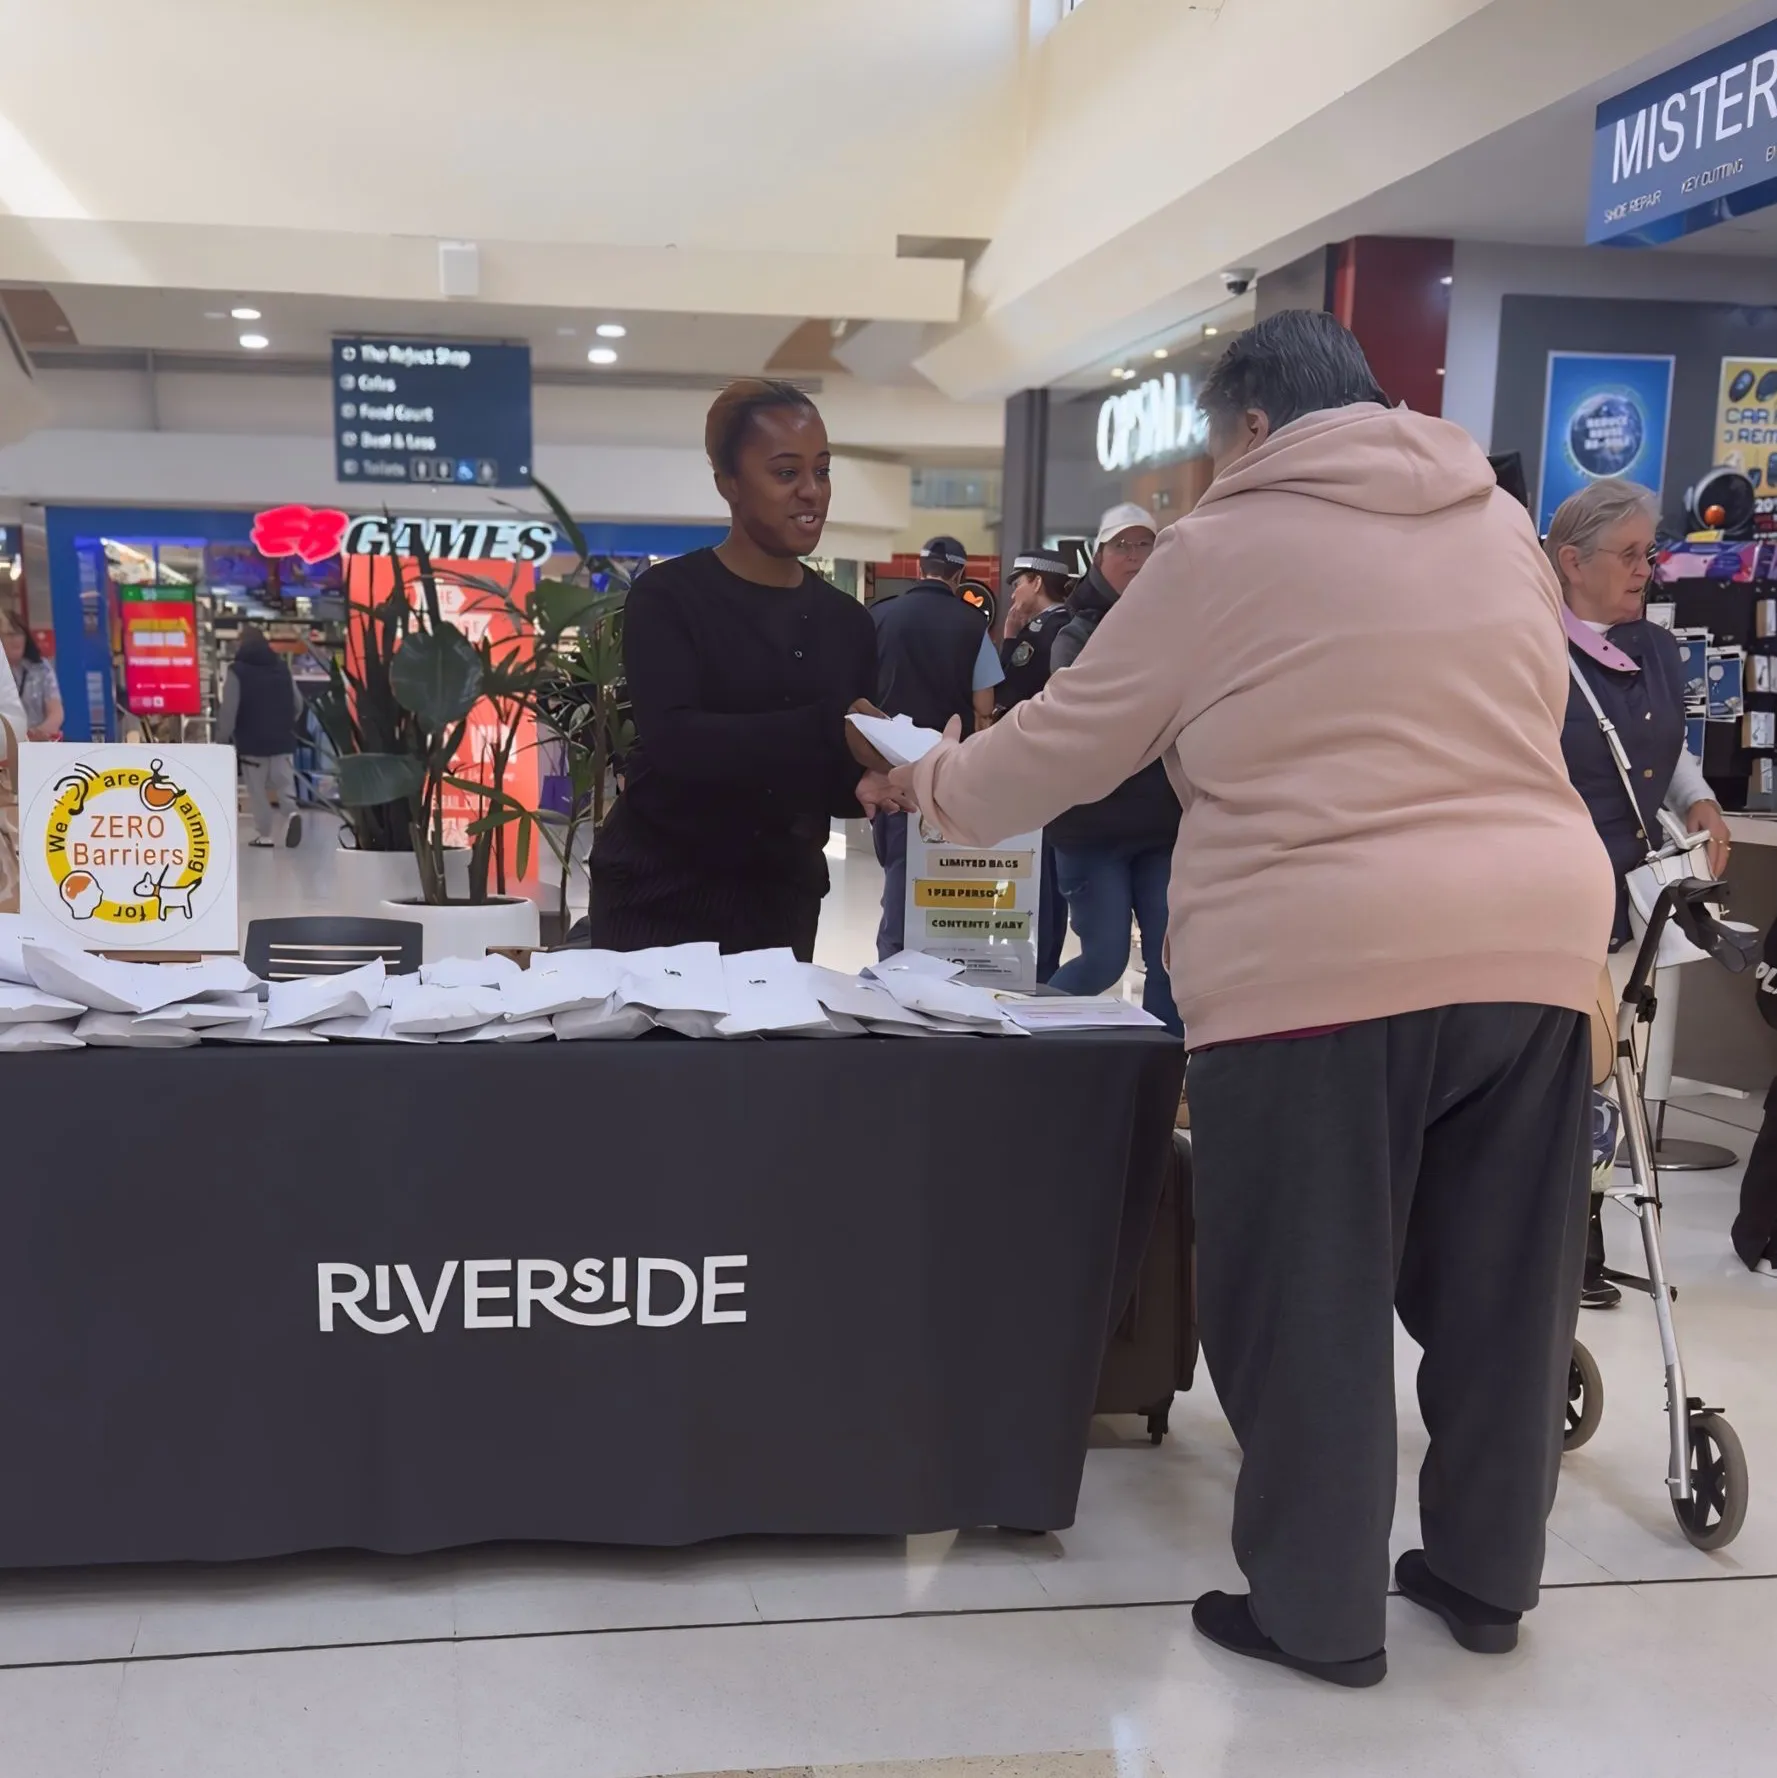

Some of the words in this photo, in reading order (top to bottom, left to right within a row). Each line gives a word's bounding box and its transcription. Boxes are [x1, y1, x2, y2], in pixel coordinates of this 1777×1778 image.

[1612, 50, 1777, 184] MISTER
[1604, 203, 1627, 224] SHOE
[1629, 190, 1662, 213] REPAIR
[1681, 175, 1700, 194] KEY
[1702, 158, 1743, 186] CUTTING
[1725, 407, 1768, 424] CAR
[344, 516, 555, 565] GAMES
[103, 773, 140, 788] are
[49, 822, 68, 853] We
[90, 815, 164, 839] ZERO
[179, 802, 209, 872] aiming
[73, 843, 183, 866] Barriers
[940, 859, 987, 868] LIMITED
[988, 860, 1018, 869] BAGS
[928, 888, 933, 897] 1
[934, 889, 955, 897] PER
[113, 906, 146, 922] for
[932, 919, 990, 929] CONTENTS
[317, 1255, 748, 1334] RIVERSIDE
